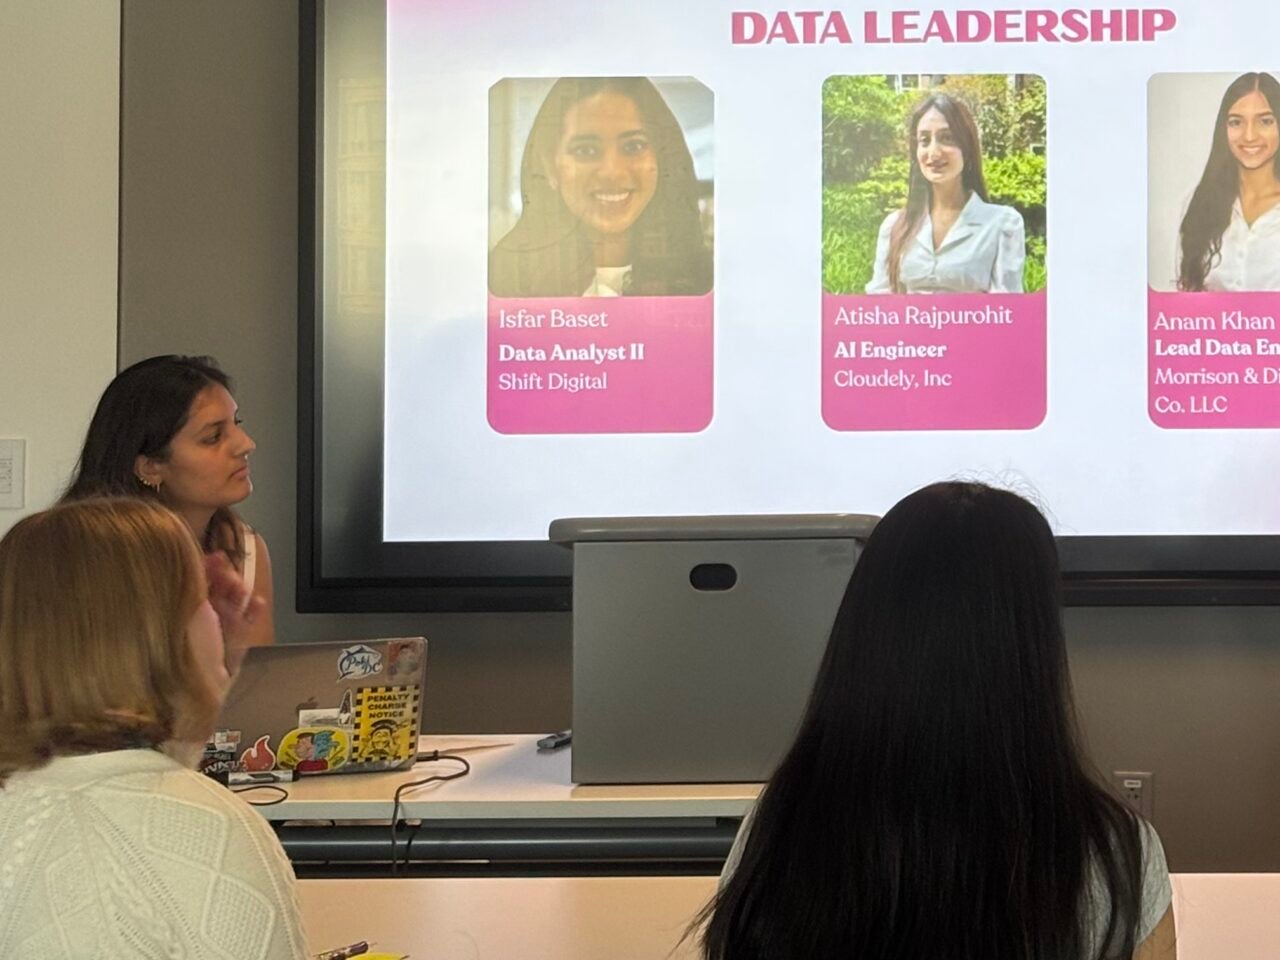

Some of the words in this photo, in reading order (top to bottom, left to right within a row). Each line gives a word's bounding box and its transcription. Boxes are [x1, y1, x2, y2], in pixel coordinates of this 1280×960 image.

[731, 11, 852, 44] DATA
[864, 9, 1177, 43] LEADERSHIP
[500, 309, 545, 328] Isfar
[550, 309, 608, 328] Baset
[834, 306, 899, 325] Atisha
[905, 305, 1013, 329] Rajpurohit
[1154, 312, 1216, 330] Anam
[1221, 311, 1275, 330] Khan
[499, 344, 546, 361] Data
[550, 343, 626, 364] Analyst
[630, 343, 644, 360] II
[834, 341, 856, 358] AI
[861, 341, 947, 360] Engineer
[1155, 339, 1201, 356] Lead
[1205, 339, 1252, 356] Data
[498, 372, 543, 390] Shift
[549, 372, 607, 392] Digital
[834, 369, 919, 390] Cloudely,
[924, 370, 952, 386] Inc
[1155, 368, 1239, 384] Morrison
[1244, 368, 1259, 384] &
[1155, 396, 1185, 413] Co.
[1190, 396, 1227, 413] LLC
[367, 693, 409, 702] PENALTY
